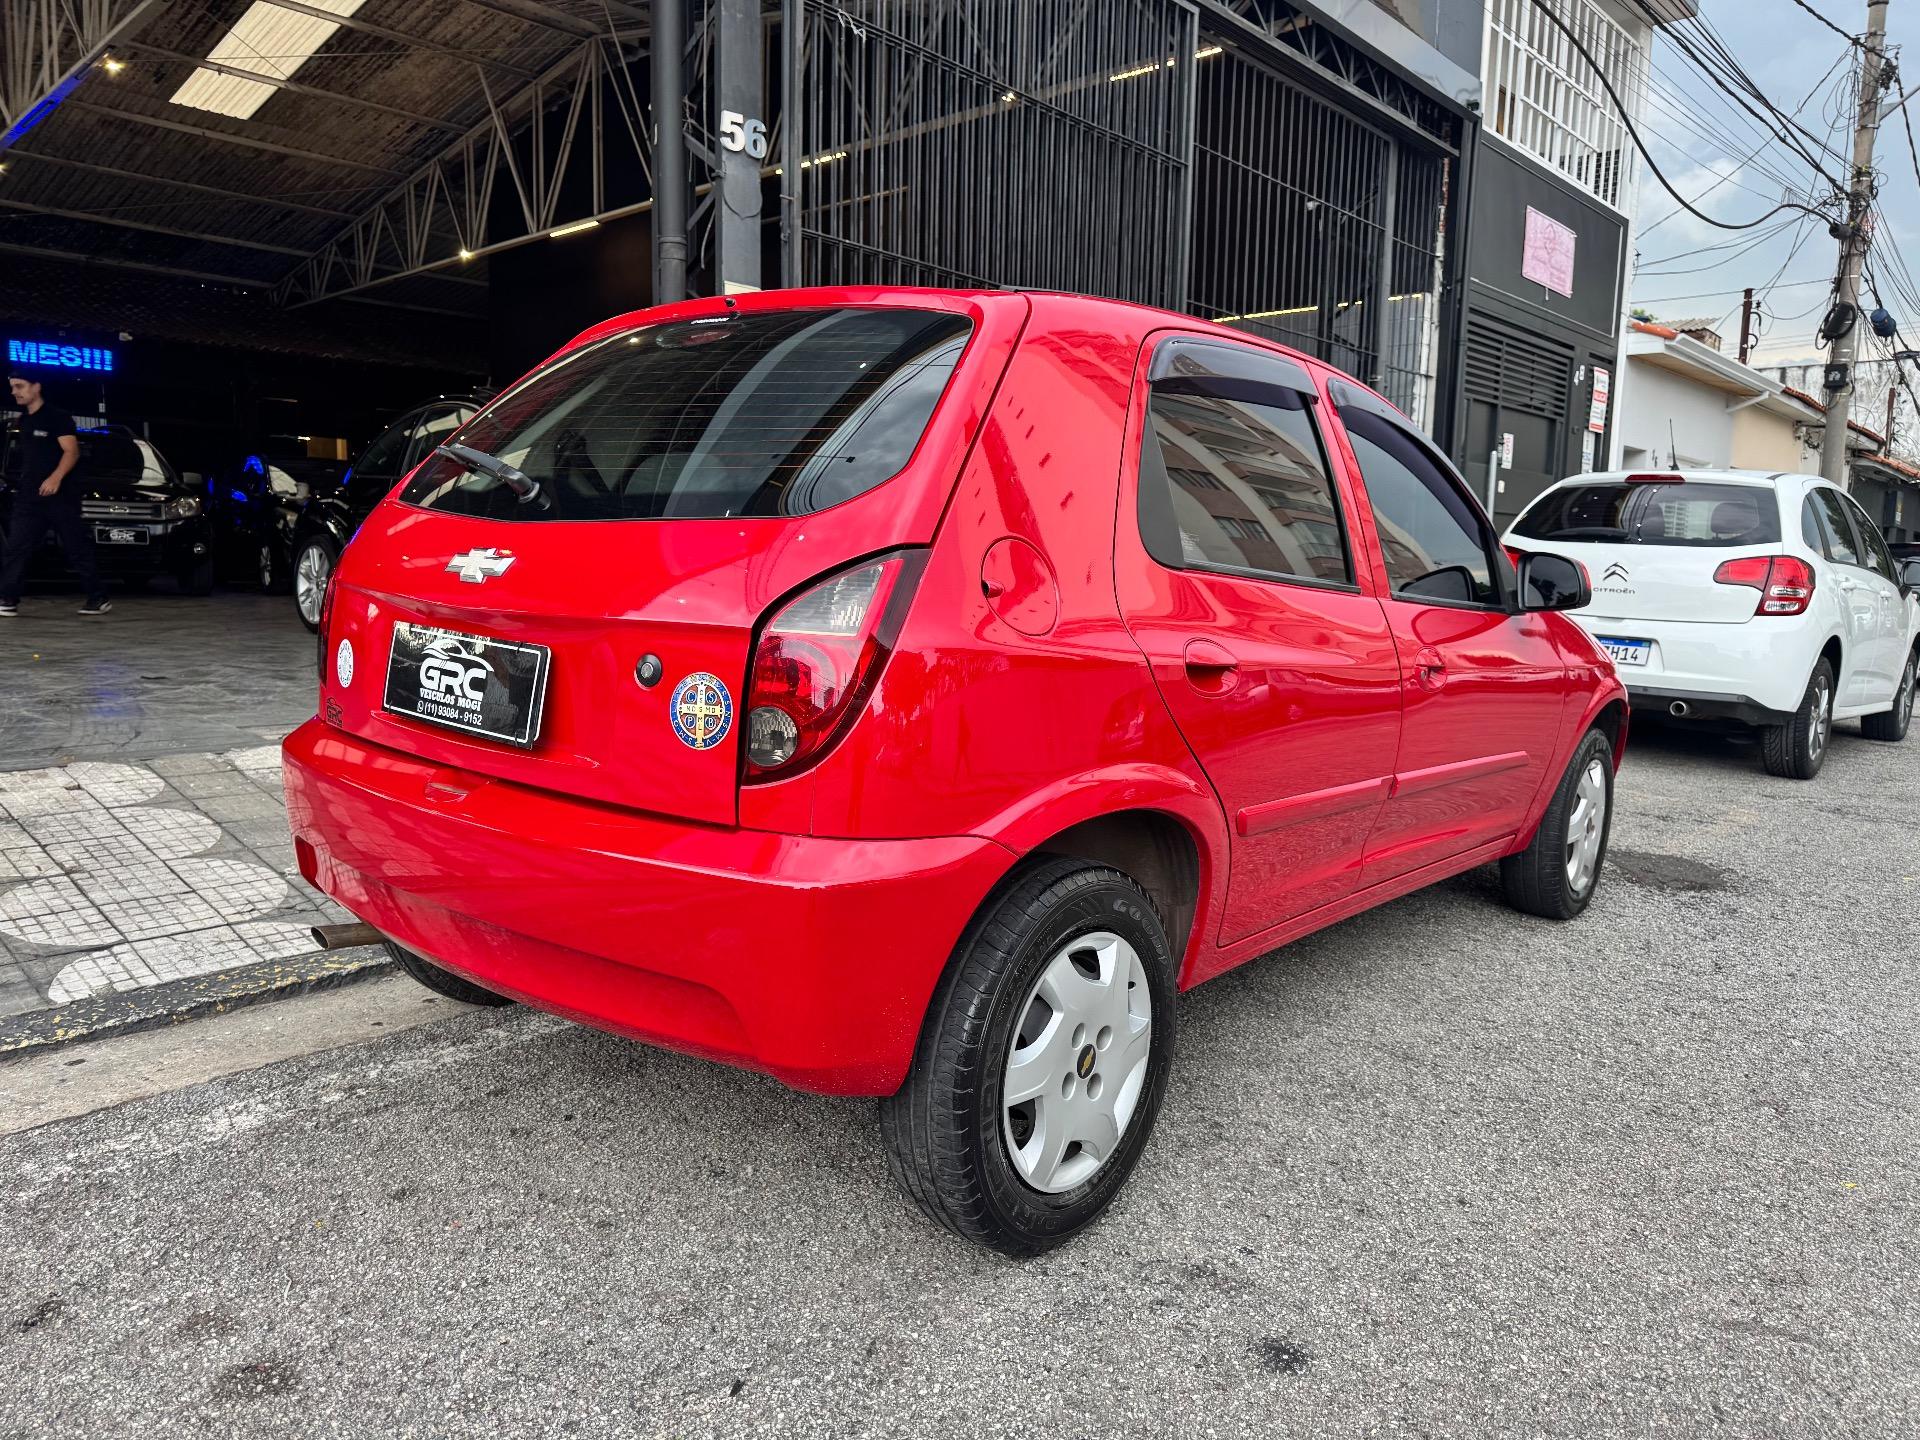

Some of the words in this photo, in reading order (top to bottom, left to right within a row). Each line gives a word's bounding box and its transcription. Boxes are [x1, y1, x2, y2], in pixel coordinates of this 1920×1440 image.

[720, 110, 767, 159] 56
[9, 340, 112, 370] MES!!!
[420, 657, 487, 701] GRC
[420, 688, 455, 705] VEICULOS
[457, 697, 482, 711] MOGI
